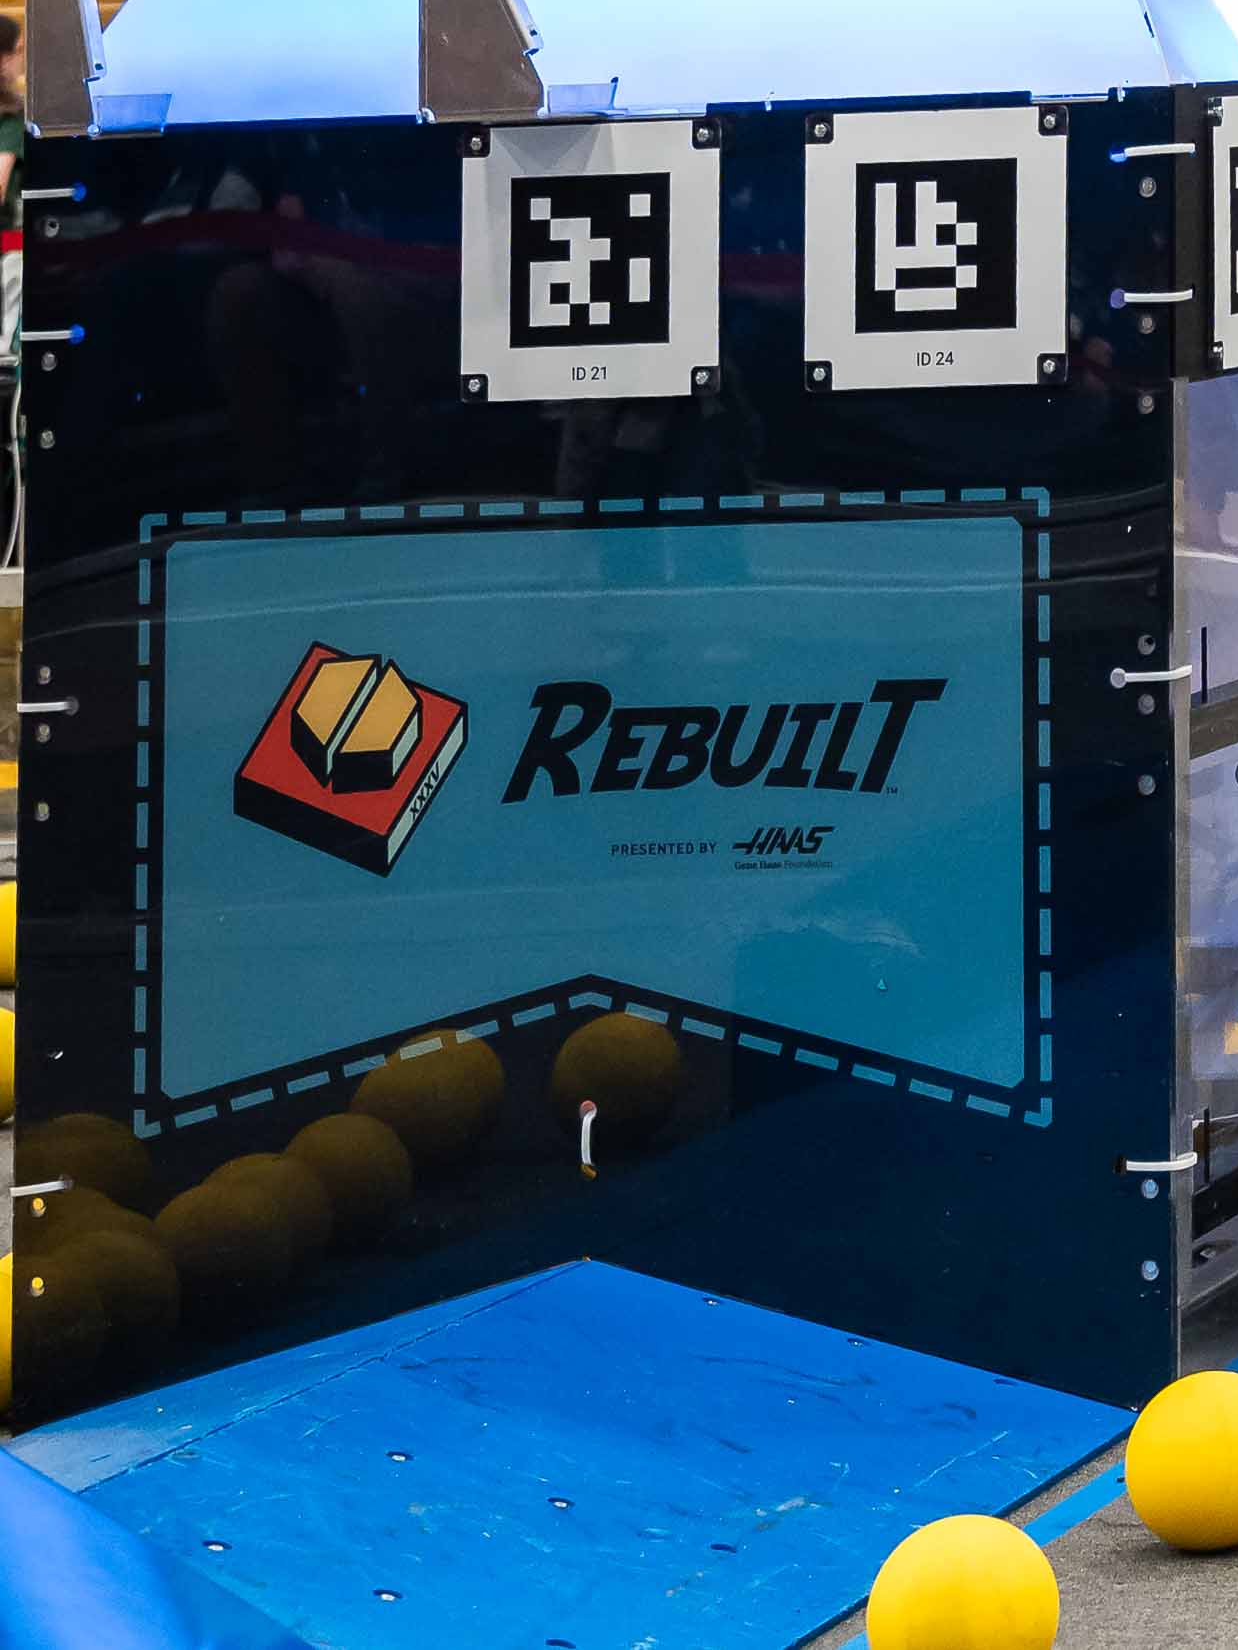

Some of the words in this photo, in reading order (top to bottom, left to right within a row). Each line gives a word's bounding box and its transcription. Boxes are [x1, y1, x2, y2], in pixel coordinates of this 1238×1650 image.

[916, 352, 931, 366] ID
[935, 351, 954, 365] 24
[571, 366, 586, 381] ID
[590, 366, 607, 380] 21
[409, 761, 440, 822] XXXV
[611, 842, 694, 856] PRESENTED
[699, 842, 718, 855] BY
